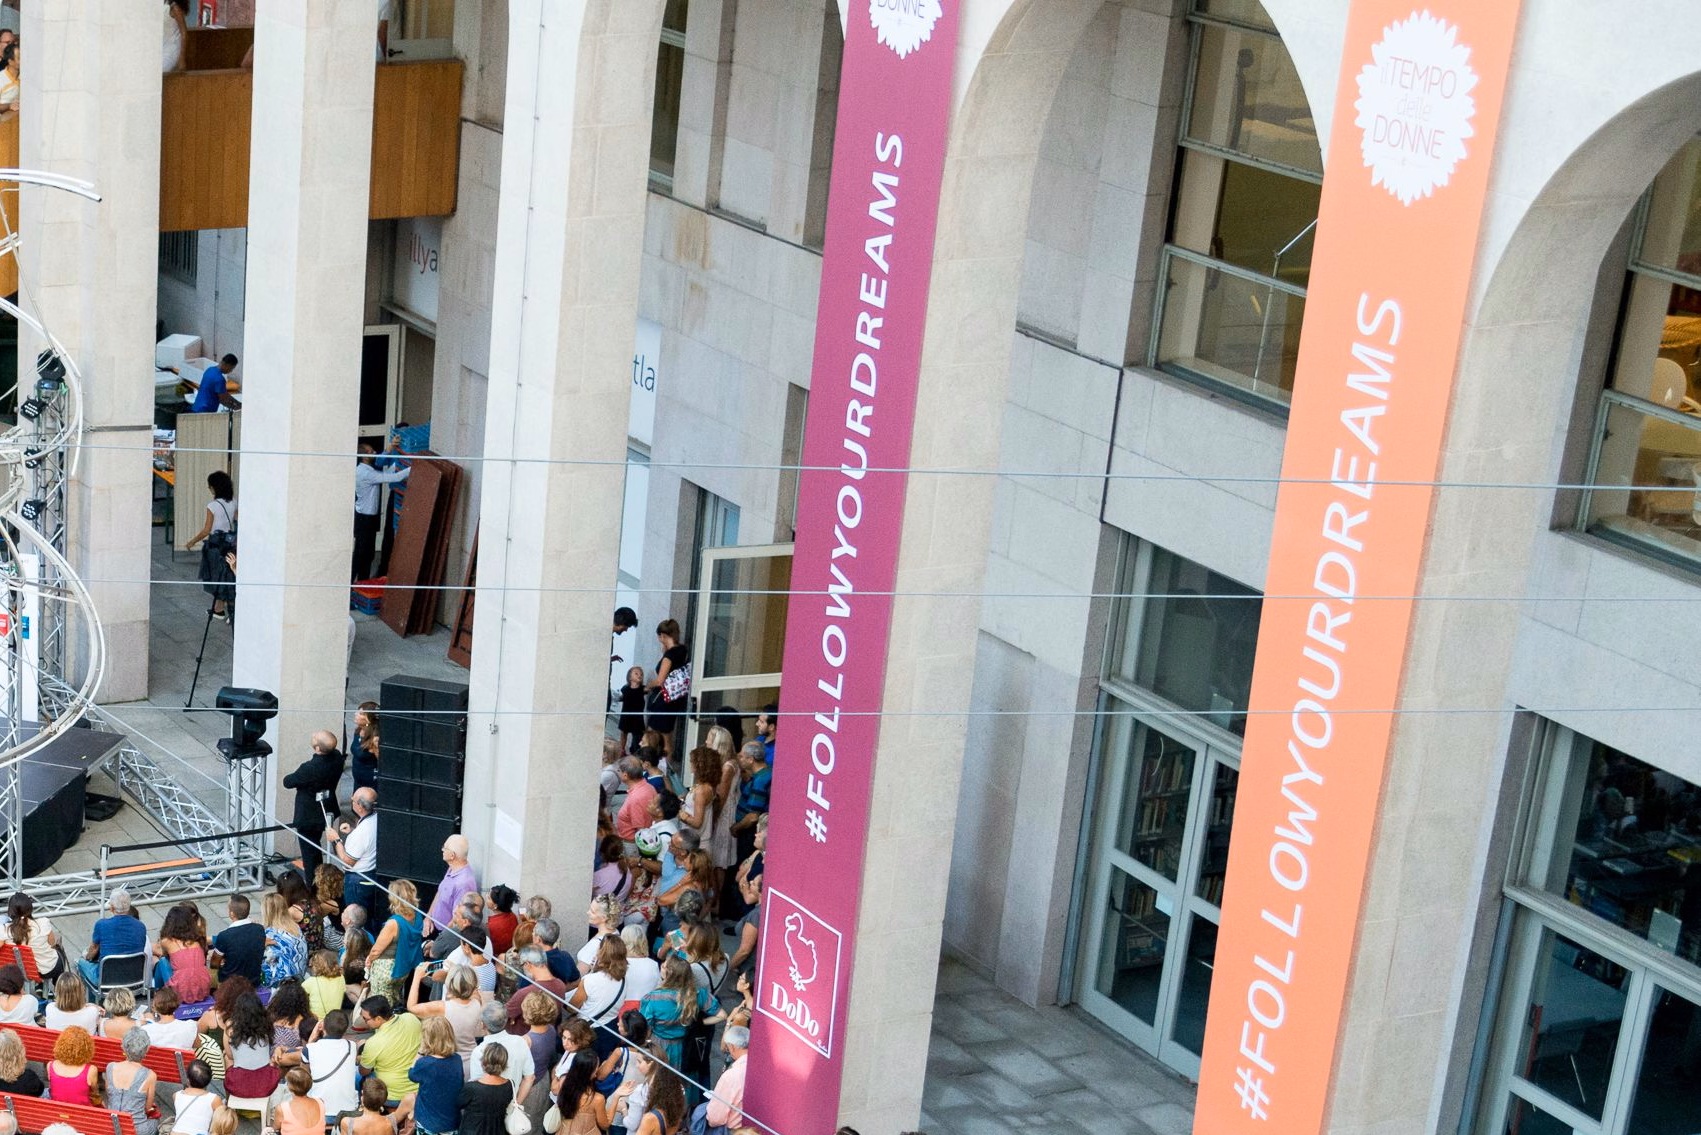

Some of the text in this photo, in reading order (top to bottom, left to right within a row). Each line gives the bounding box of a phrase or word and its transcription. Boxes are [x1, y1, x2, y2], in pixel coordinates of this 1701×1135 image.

[1390, 55, 1458, 100] TEMPO
[1397, 92, 1433, 123] delle
[1372, 113, 1446, 160] DONNE
[804, 131, 903, 843] #FOLLOWYOURDREAMS
[1232, 292, 1403, 1121] #FOLLOWYOURDREAMS
[770, 982, 820, 1037] DoDo
